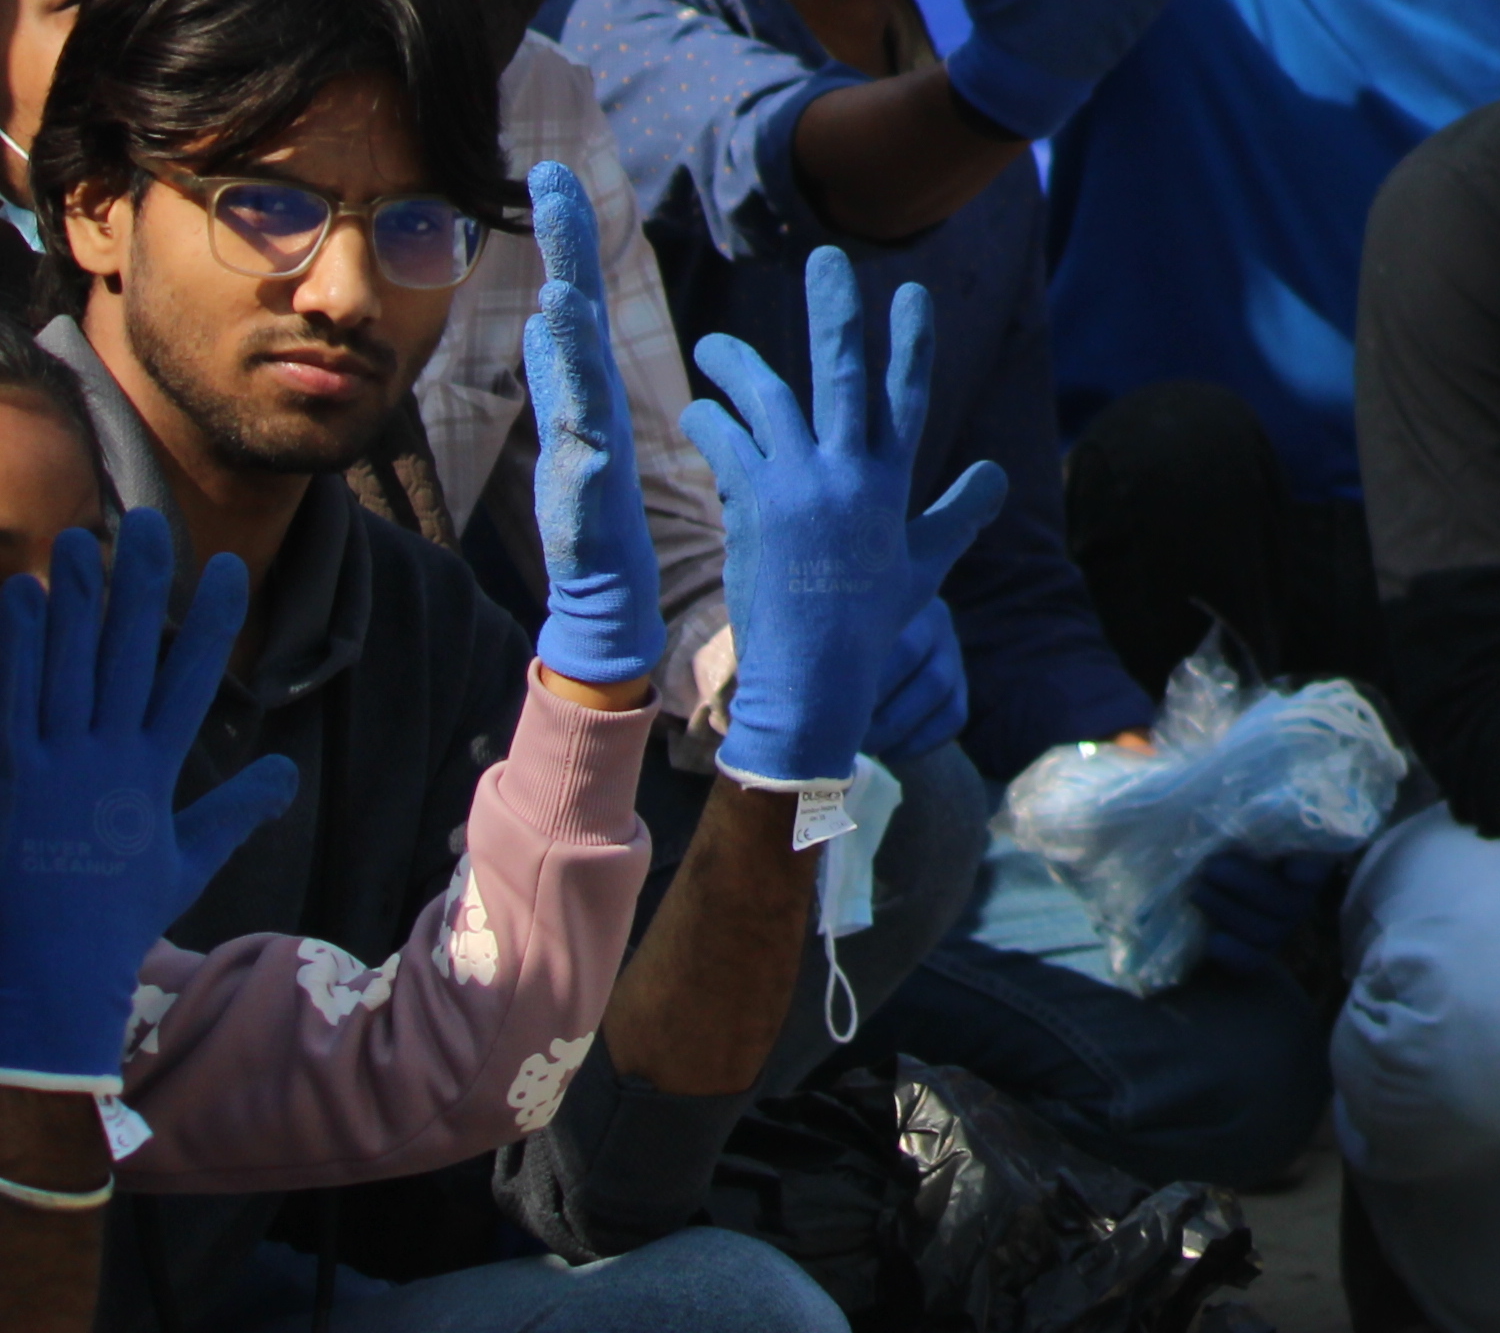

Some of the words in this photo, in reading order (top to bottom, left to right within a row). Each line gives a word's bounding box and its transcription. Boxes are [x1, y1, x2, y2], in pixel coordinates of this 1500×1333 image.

[787, 559, 848, 577] RIVER
[787, 578, 874, 595] CLEANUP
[22, 838, 92, 857] RIVER
[20, 856, 128, 877] CLEANUP
